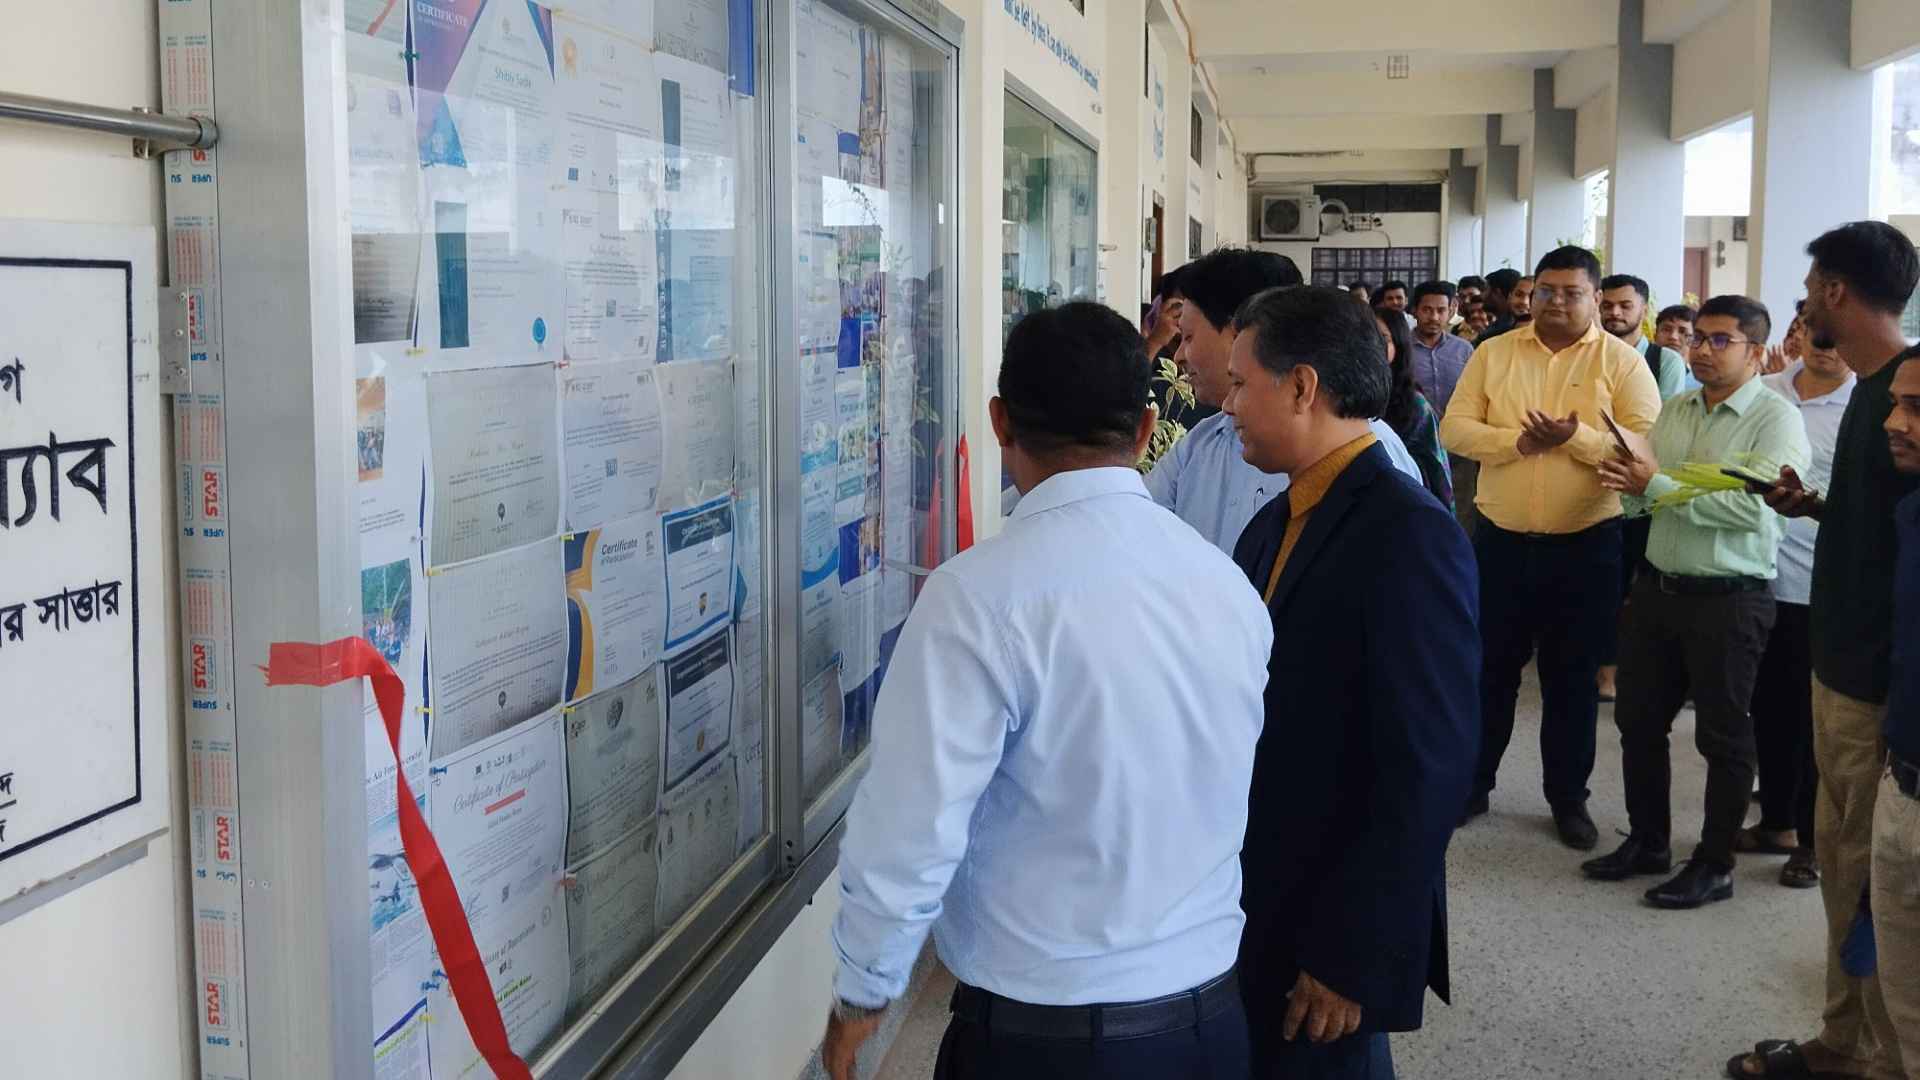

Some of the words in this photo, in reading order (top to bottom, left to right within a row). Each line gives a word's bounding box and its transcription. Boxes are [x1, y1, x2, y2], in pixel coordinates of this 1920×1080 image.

[416, 2, 467, 26] CERTIFICATE
[204, 471, 219, 517] STAR
[601, 538, 638, 555] Certificate
[33, 579, 122, 632] সাত্তার
[193, 644, 207, 688] STAR
[192, 700, 217, 710] SUPER
[216, 816, 230, 860] STAR
[207, 983, 220, 1025] STAR
